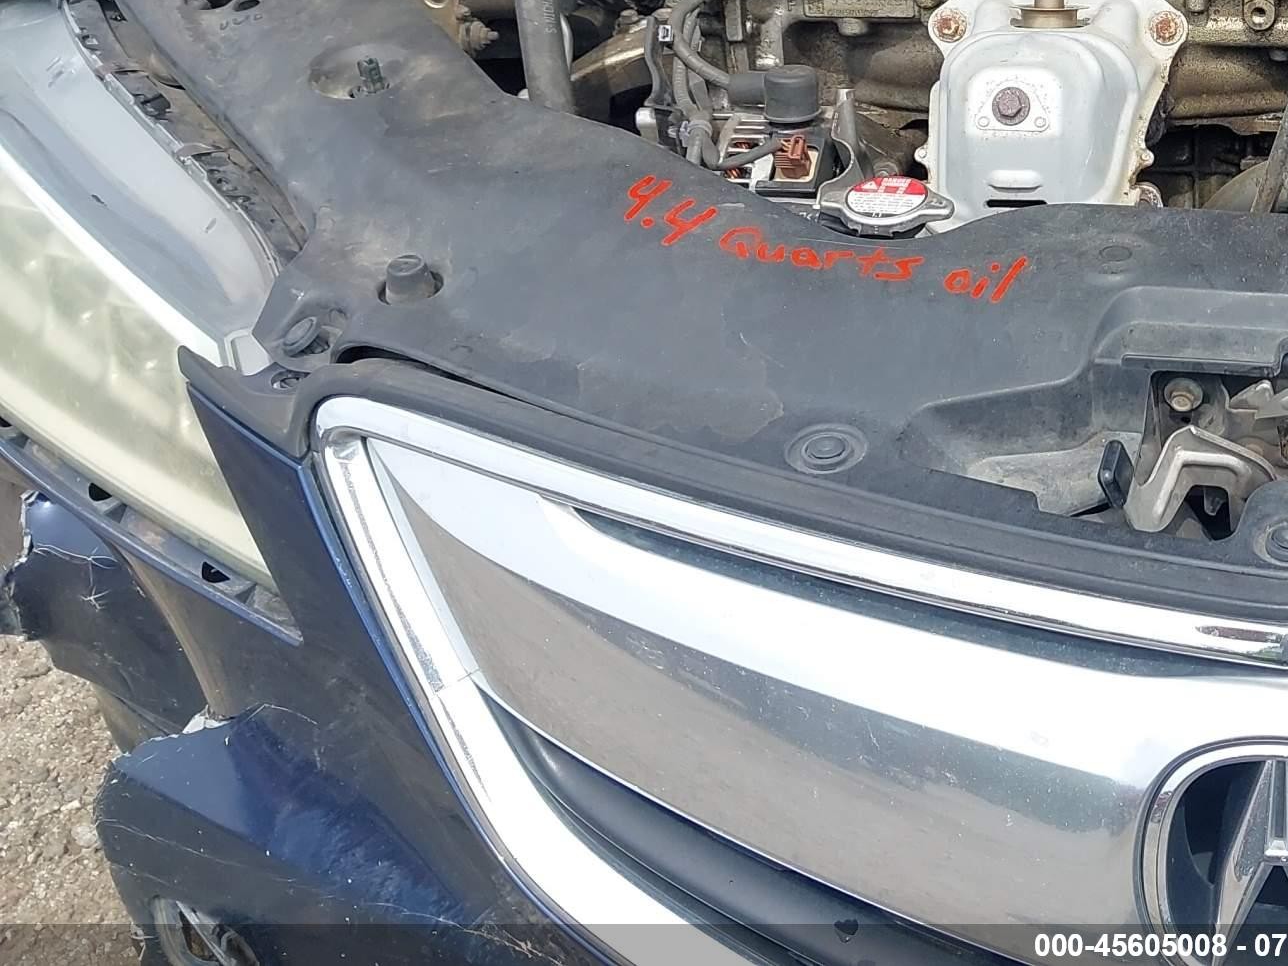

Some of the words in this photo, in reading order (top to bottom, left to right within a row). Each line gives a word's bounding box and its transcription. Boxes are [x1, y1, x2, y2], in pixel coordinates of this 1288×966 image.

[623, 174, 718, 247] 4.4
[718, 226, 925, 283] Quarts
[942, 256, 1029, 304] oil
